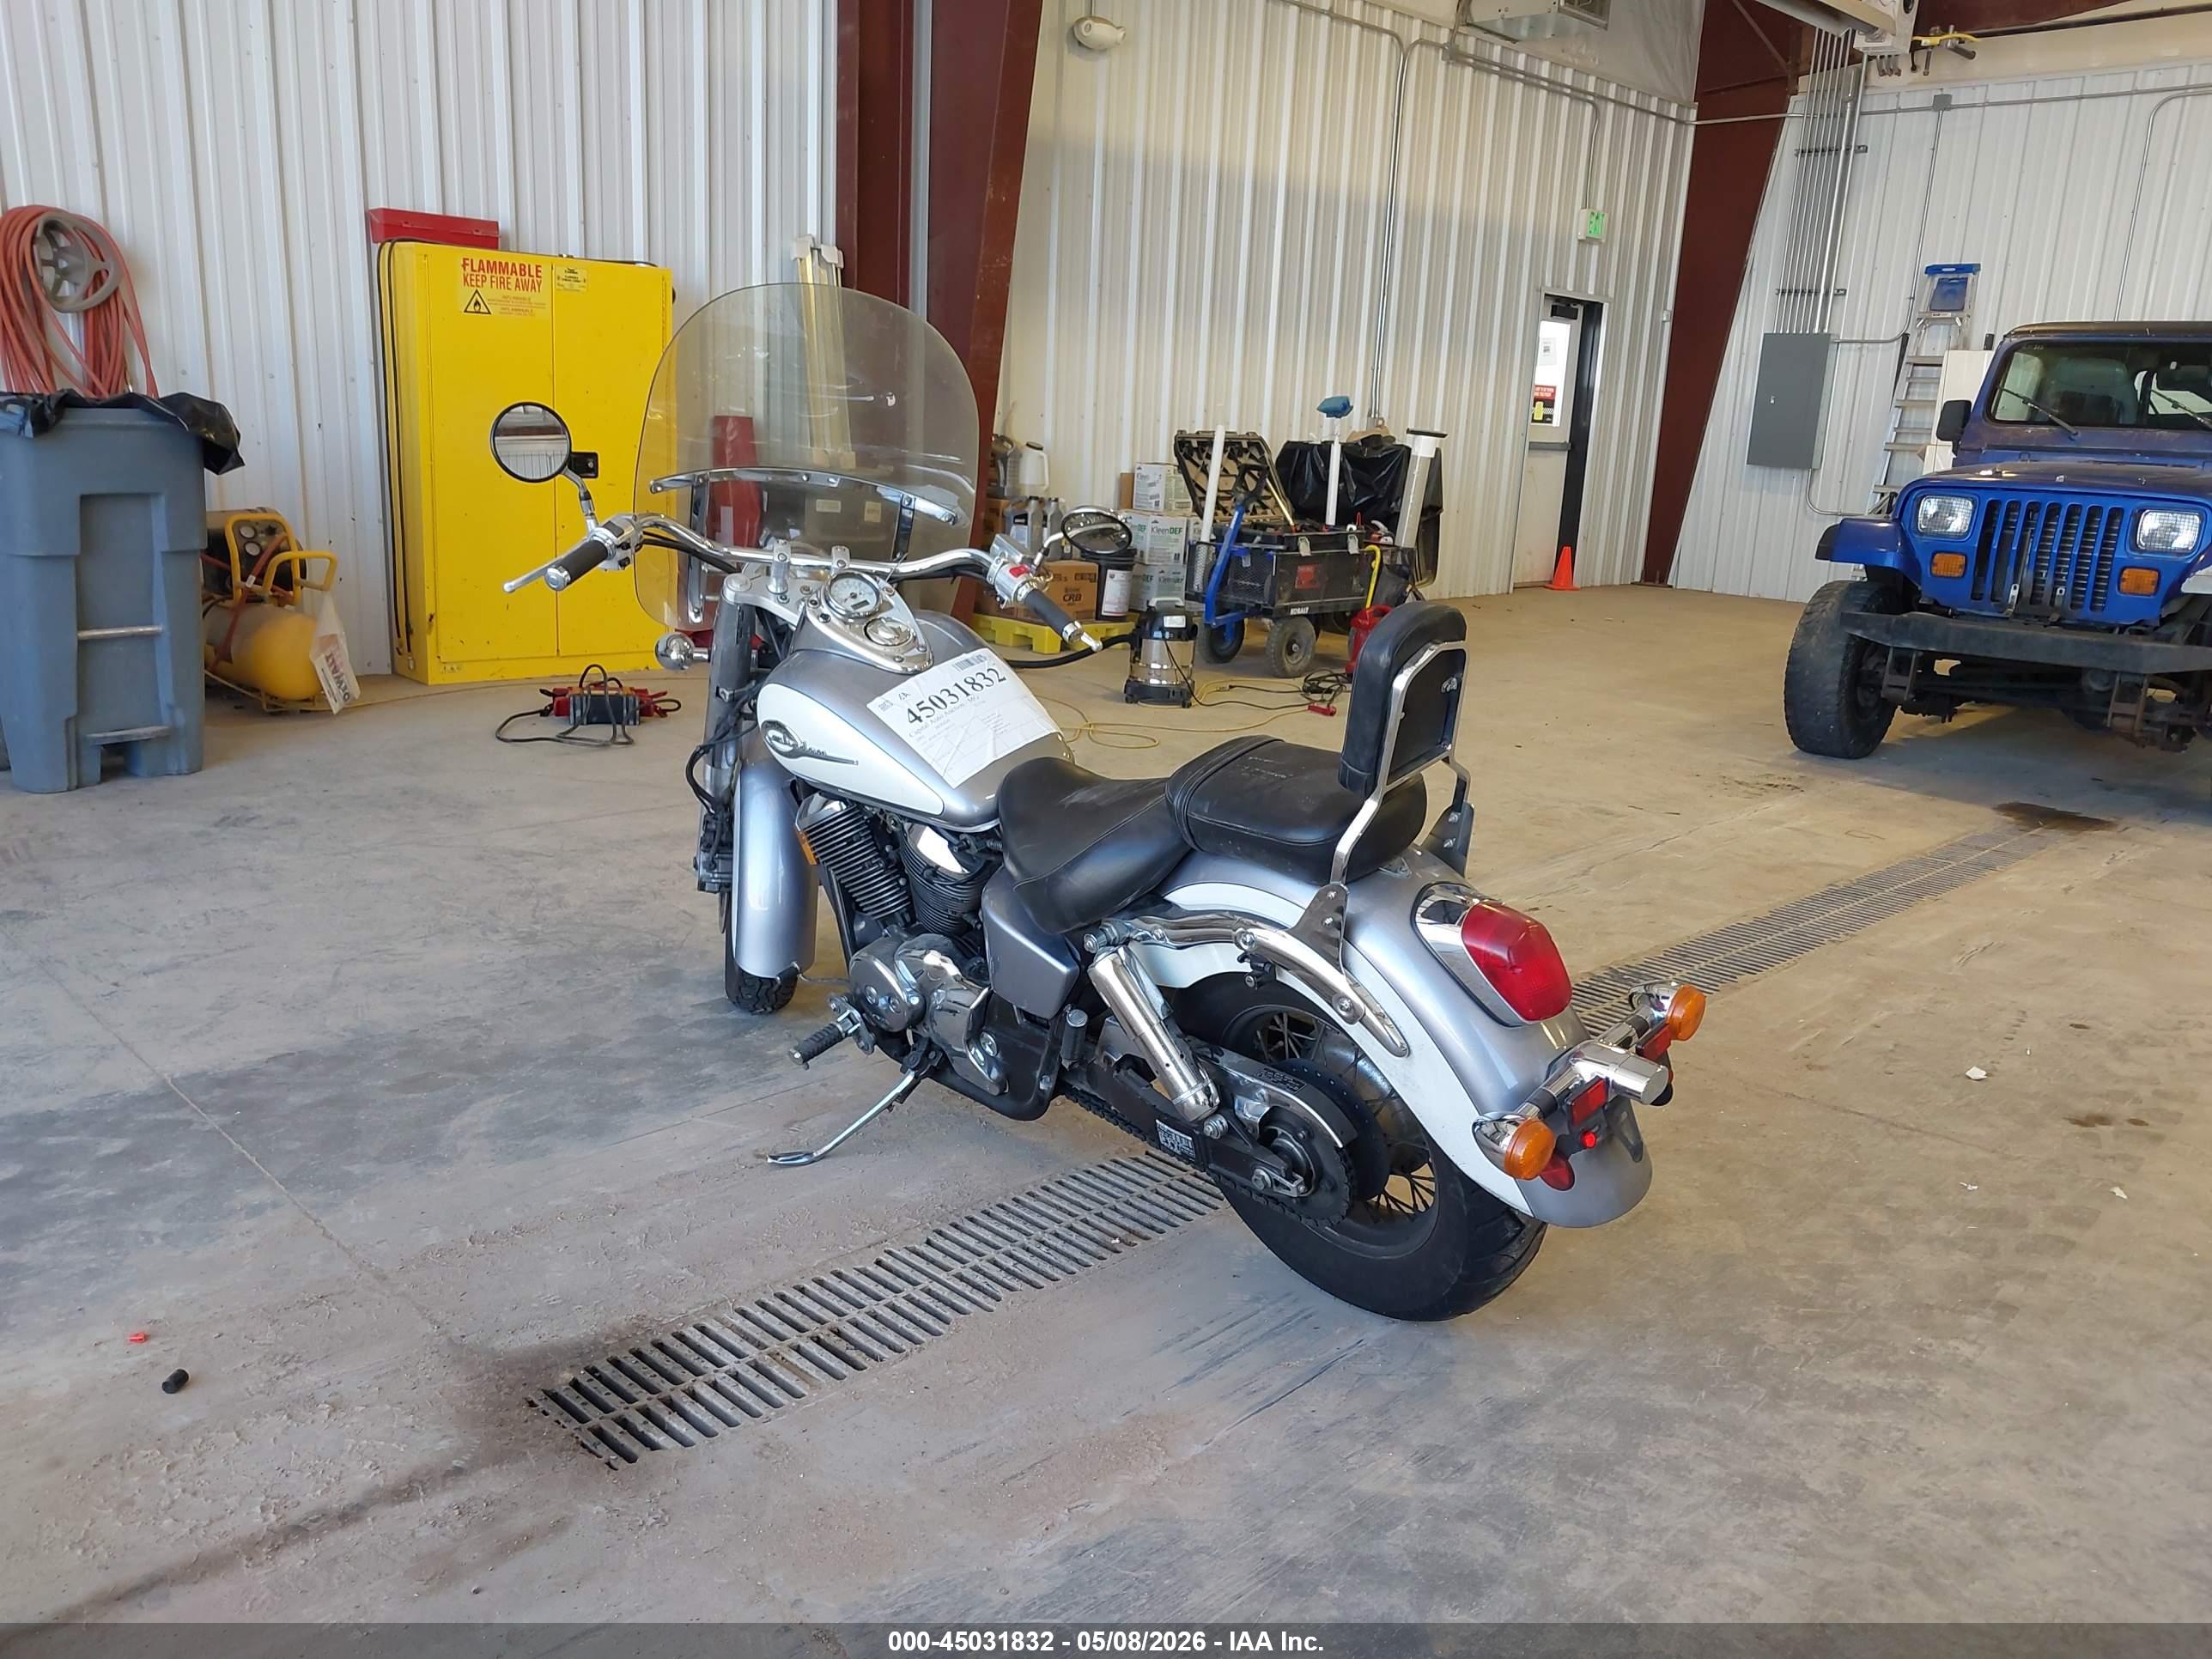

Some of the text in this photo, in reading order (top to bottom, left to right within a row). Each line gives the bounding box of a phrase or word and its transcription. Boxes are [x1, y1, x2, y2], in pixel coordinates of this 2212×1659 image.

[462, 258, 542, 278] FLAMMABLE
[463, 273, 487, 289] KEEP
[490, 276, 511, 290] FIRE
[514, 278, 542, 293] AWAY
[907, 668, 1006, 724] 45031832
